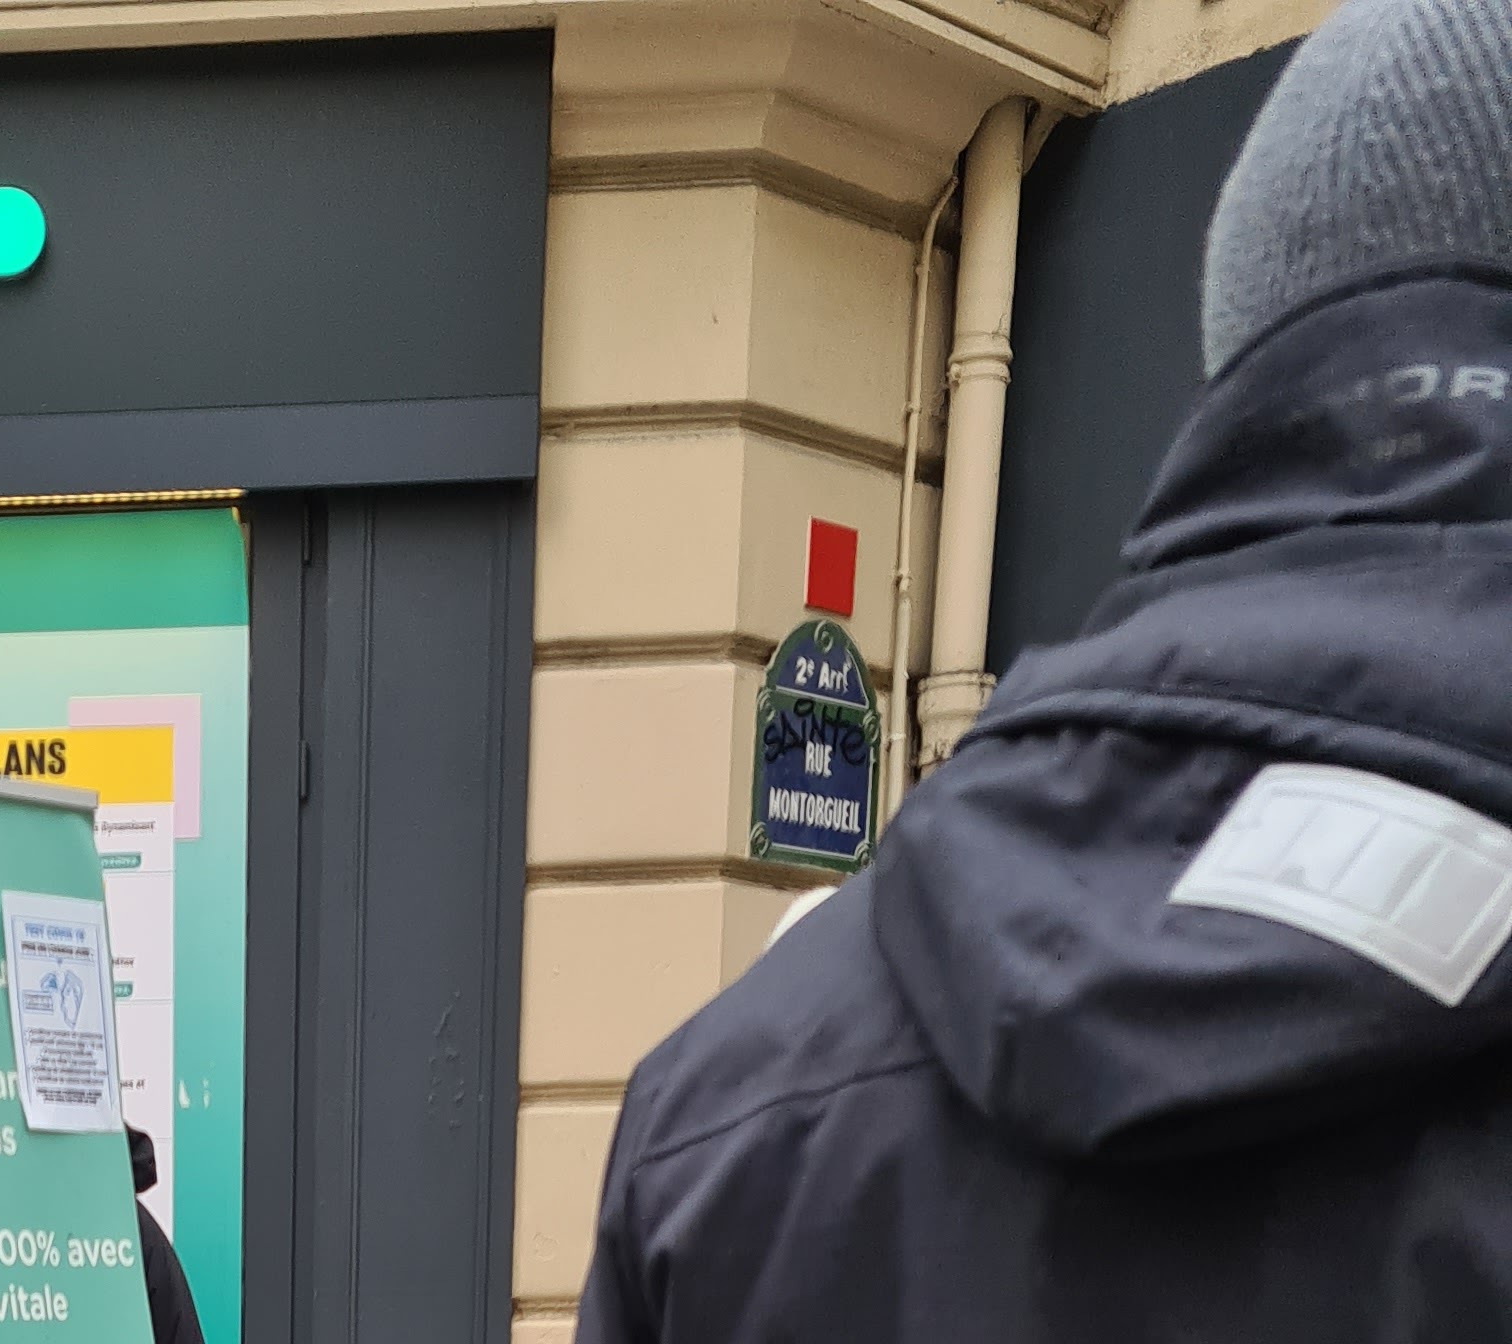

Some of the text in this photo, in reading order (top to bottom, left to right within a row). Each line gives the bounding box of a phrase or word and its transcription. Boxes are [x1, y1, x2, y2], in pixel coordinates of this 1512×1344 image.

[805, 740, 833, 778] RUE
[768, 786, 861, 834] MONTORGUEIL
[67, 1238, 135, 1268] avec
